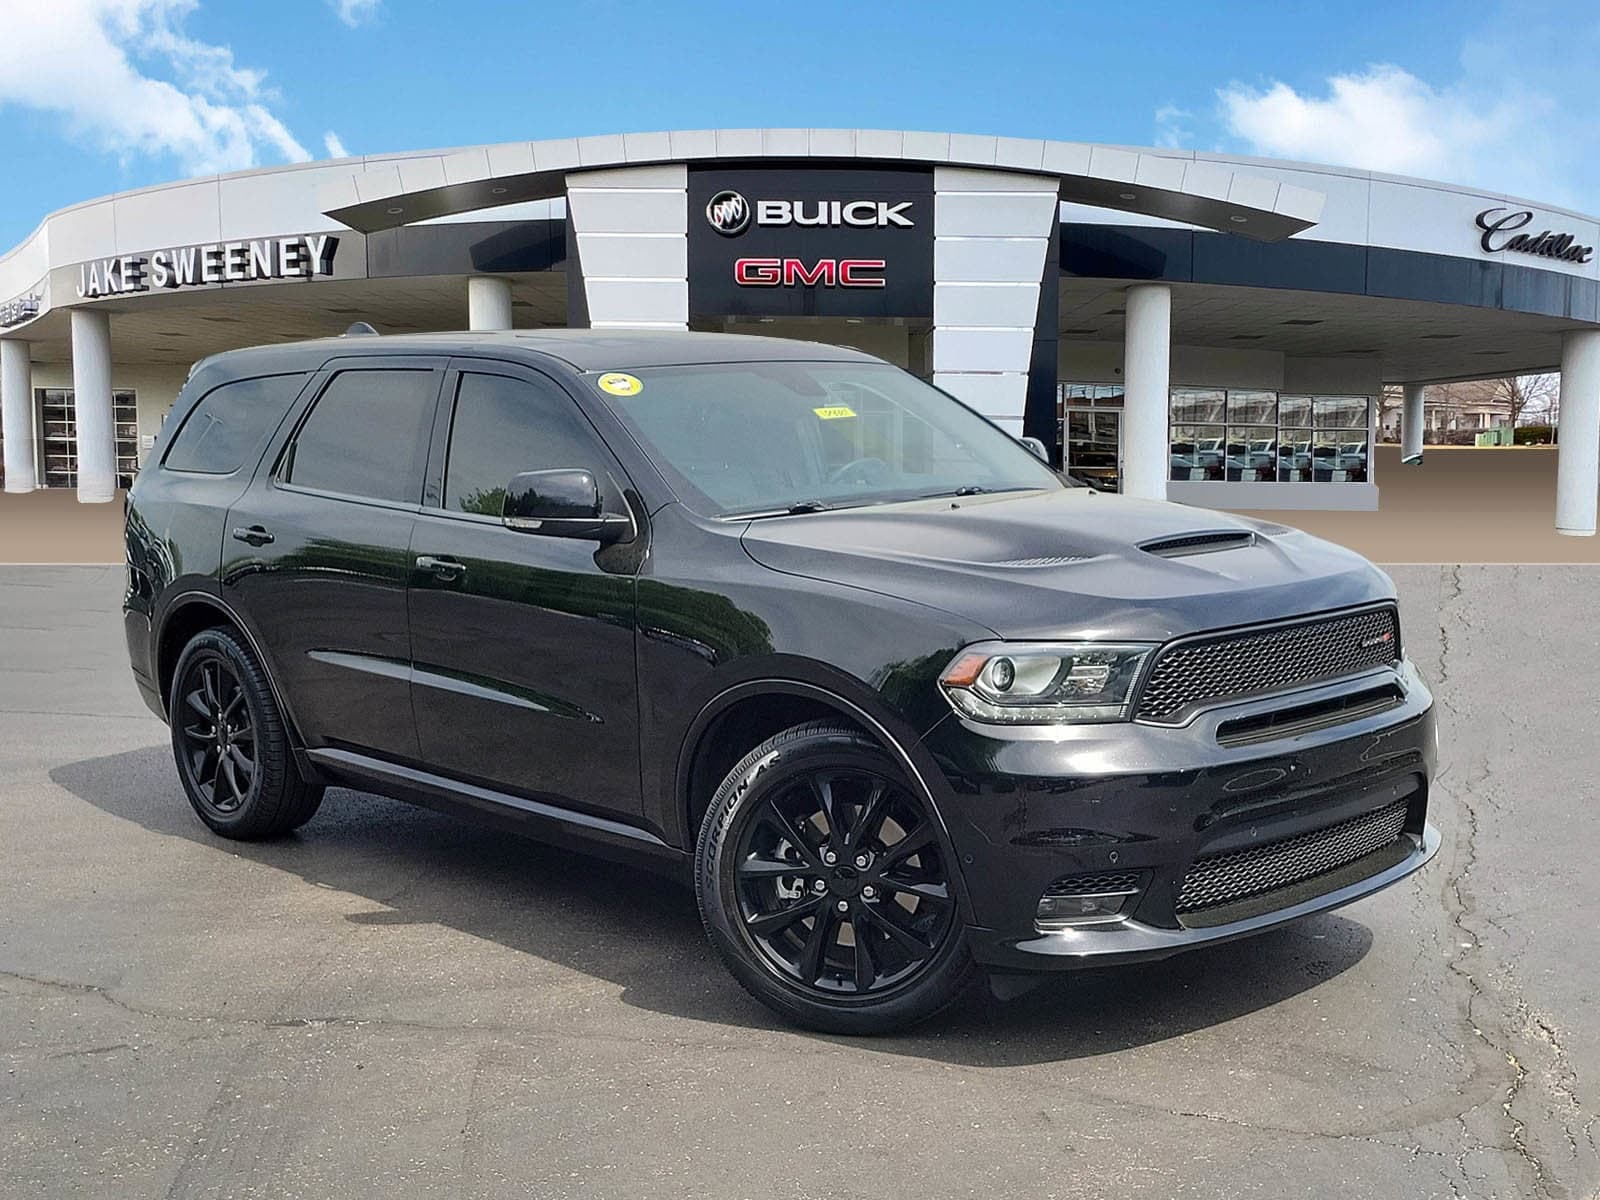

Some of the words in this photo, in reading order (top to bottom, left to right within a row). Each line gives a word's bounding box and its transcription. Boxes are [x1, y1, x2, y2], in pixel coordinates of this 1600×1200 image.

[757, 200, 915, 226] BUICK
[1475, 207, 1593, 264] Cadillac
[76, 256, 144, 298] JAKE
[151, 234, 333, 289] SWEENEY
[734, 257, 886, 287] GMC
